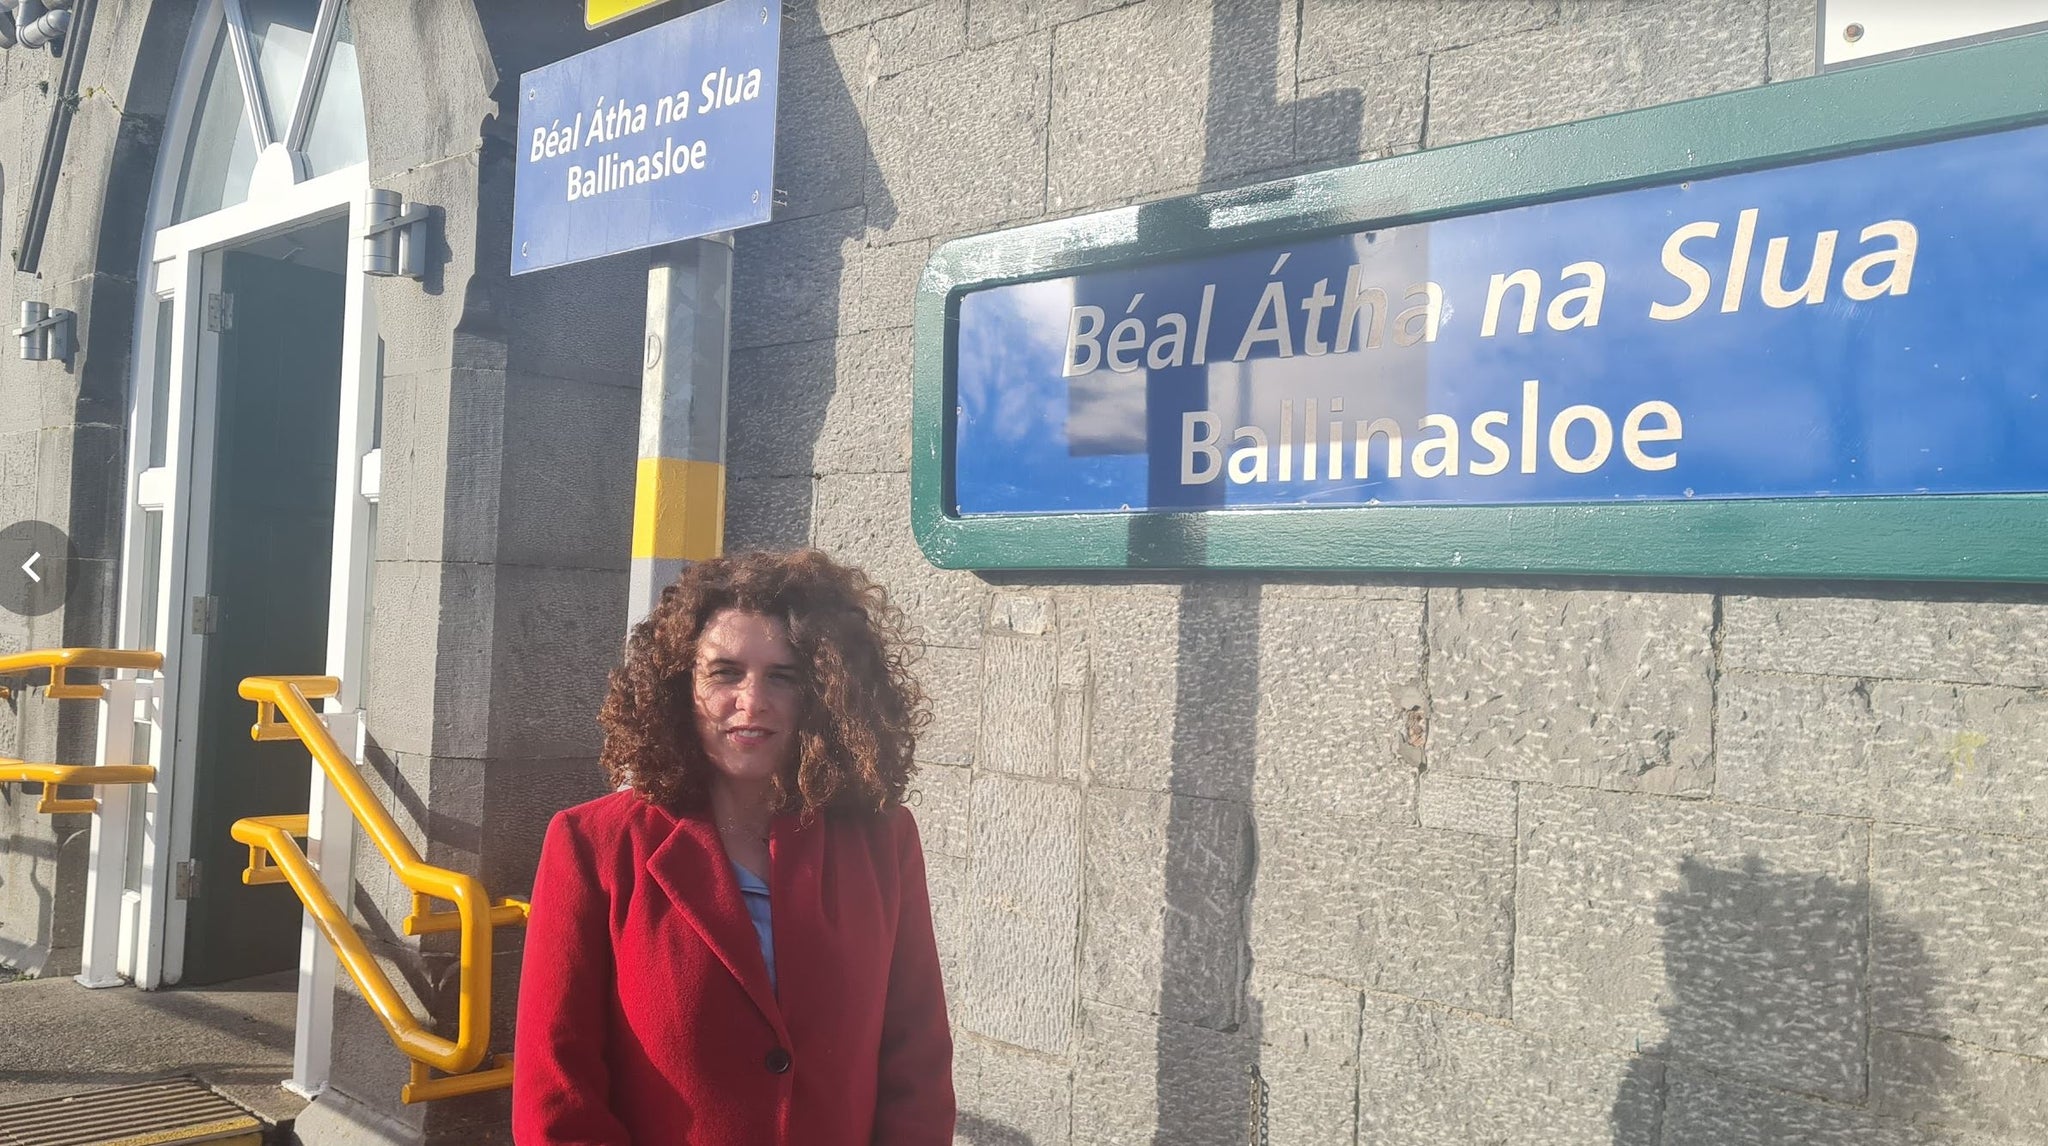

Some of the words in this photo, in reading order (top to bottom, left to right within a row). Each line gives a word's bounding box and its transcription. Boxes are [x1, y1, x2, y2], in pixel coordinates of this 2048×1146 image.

[530, 111, 582, 162] Béal
[585, 96, 647, 147] Átha
[655, 90, 690, 126] na
[698, 67, 761, 114] Slua
[567, 138, 707, 201] Ballinasloe
[1062, 284, 1216, 378] Béal
[1232, 252, 1445, 362] Átha
[1480, 260, 1607, 337] na
[1649, 208, 1918, 321] Slua
[1180, 379, 1682, 486] Ballinasloe
